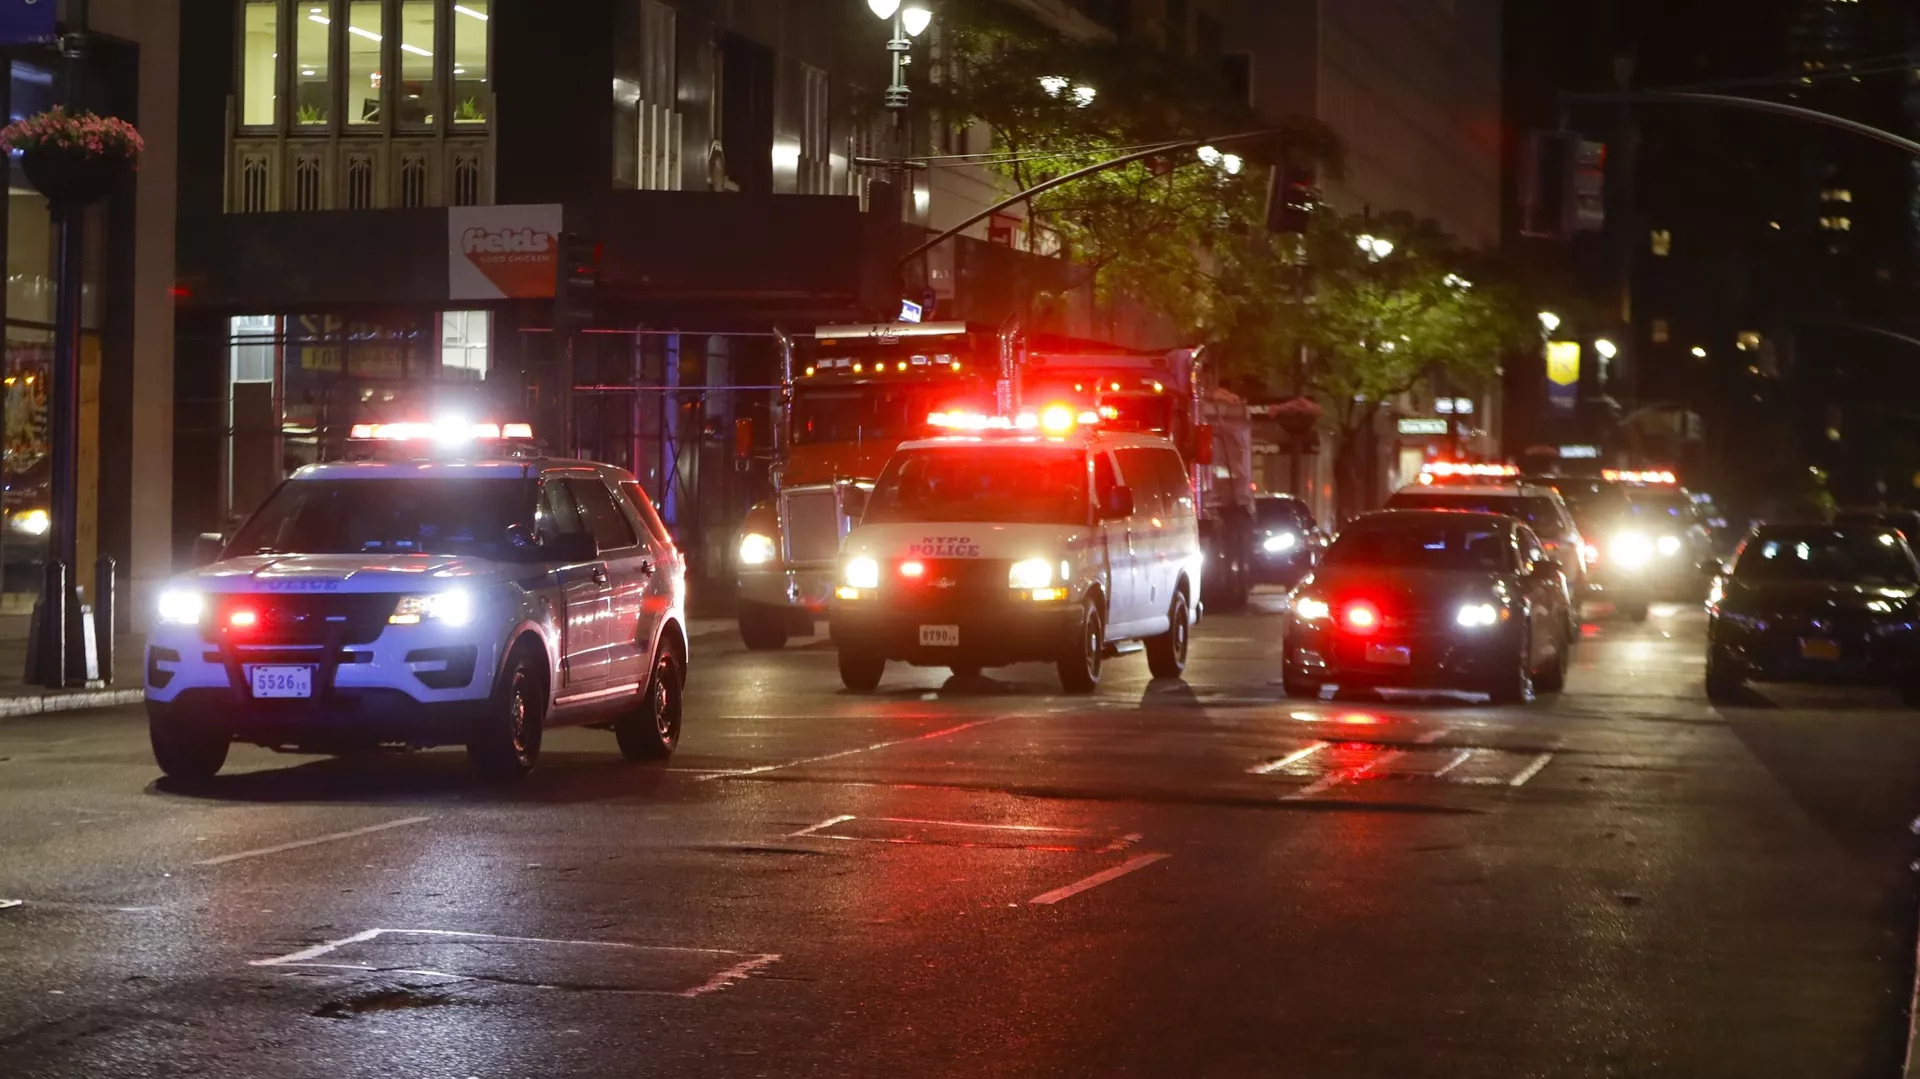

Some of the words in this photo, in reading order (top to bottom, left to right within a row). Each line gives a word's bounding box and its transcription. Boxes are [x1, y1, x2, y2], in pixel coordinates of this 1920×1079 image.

[461, 227, 550, 254] fields
[508, 254, 550, 262] CHICKEN
[909, 545, 980, 557] POLICE
[253, 579, 340, 590] POLICE
[923, 630, 948, 641] 8790
[258, 674, 295, 690] 5526
